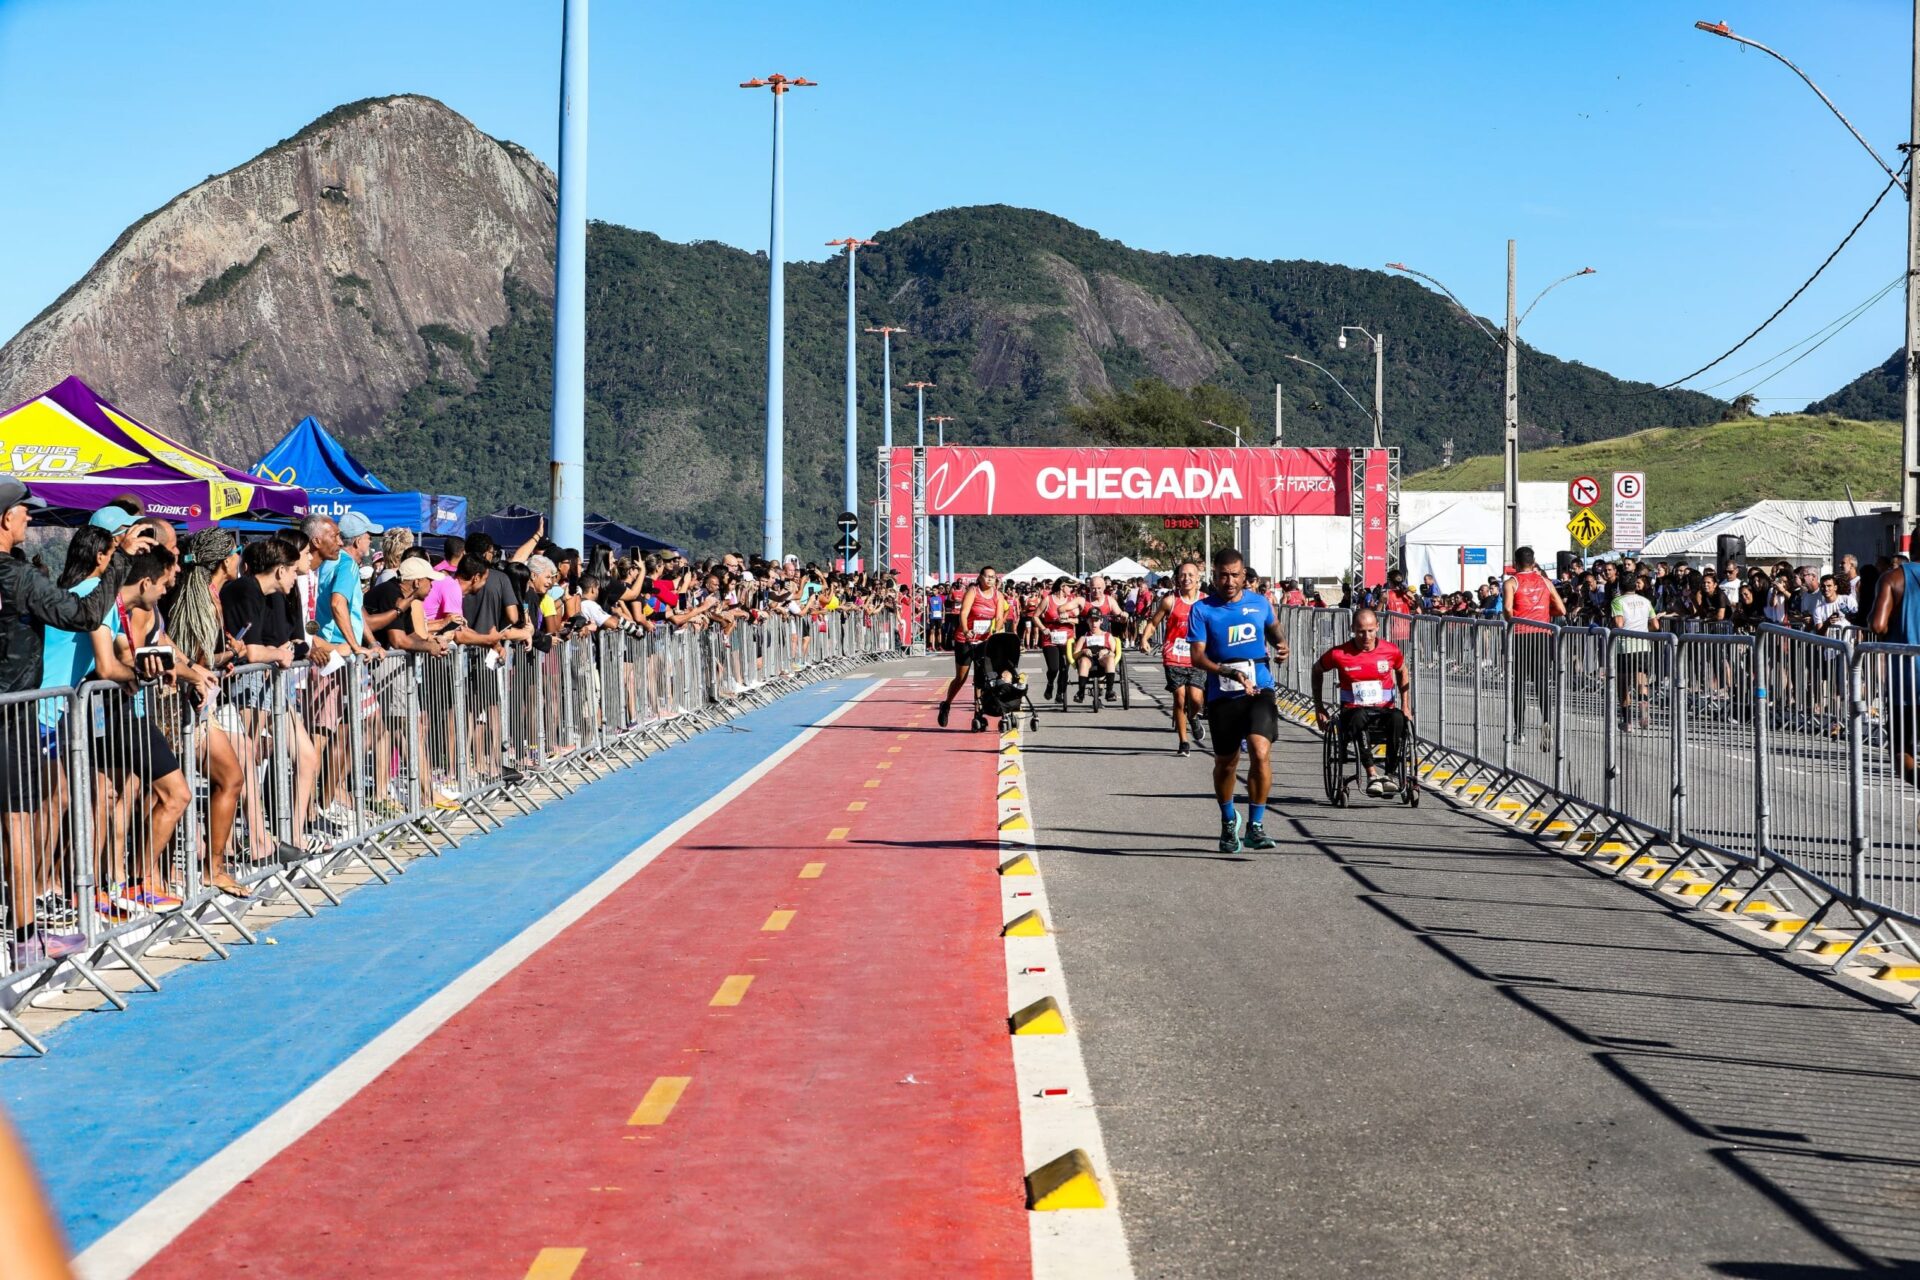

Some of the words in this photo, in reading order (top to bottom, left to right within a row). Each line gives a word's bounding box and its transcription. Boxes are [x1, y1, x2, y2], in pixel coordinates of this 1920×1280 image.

[12, 445, 80, 455] EQUIPE
[1036, 466, 1243, 500] CHEGADA
[1624, 480, 1633, 493] E
[308, 501, 351, 516] rg.br
